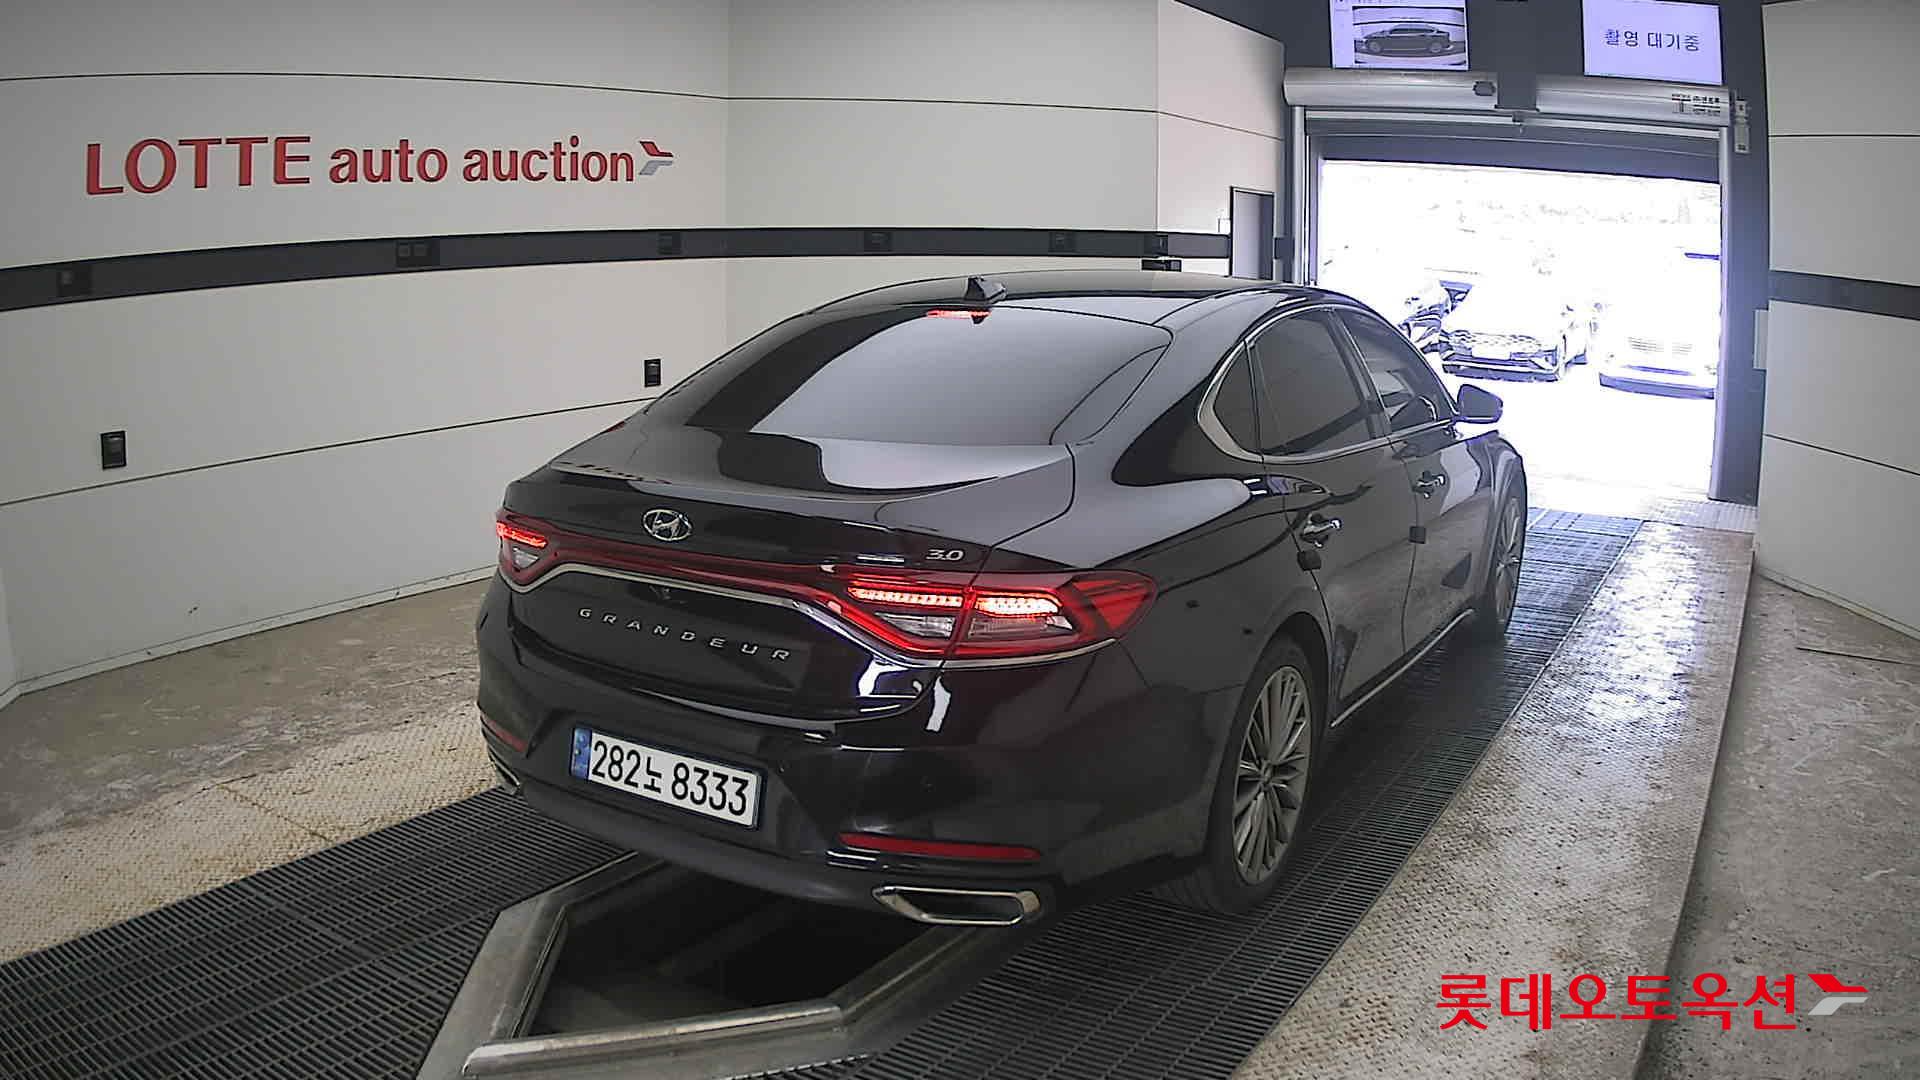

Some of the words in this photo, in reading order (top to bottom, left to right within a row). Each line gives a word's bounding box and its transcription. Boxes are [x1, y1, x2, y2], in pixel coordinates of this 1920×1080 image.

[1647, 32, 1699, 52] 대기중
[86, 136, 311, 196] LOTTE
[328, 139, 448, 184] auto
[462, 135, 635, 183] auction
[925, 548, 965, 561] 3.0
[579, 607, 790, 661] GRANDEUR
[591, 740, 663, 795] 282노
[671, 762, 749, 816] 8333
